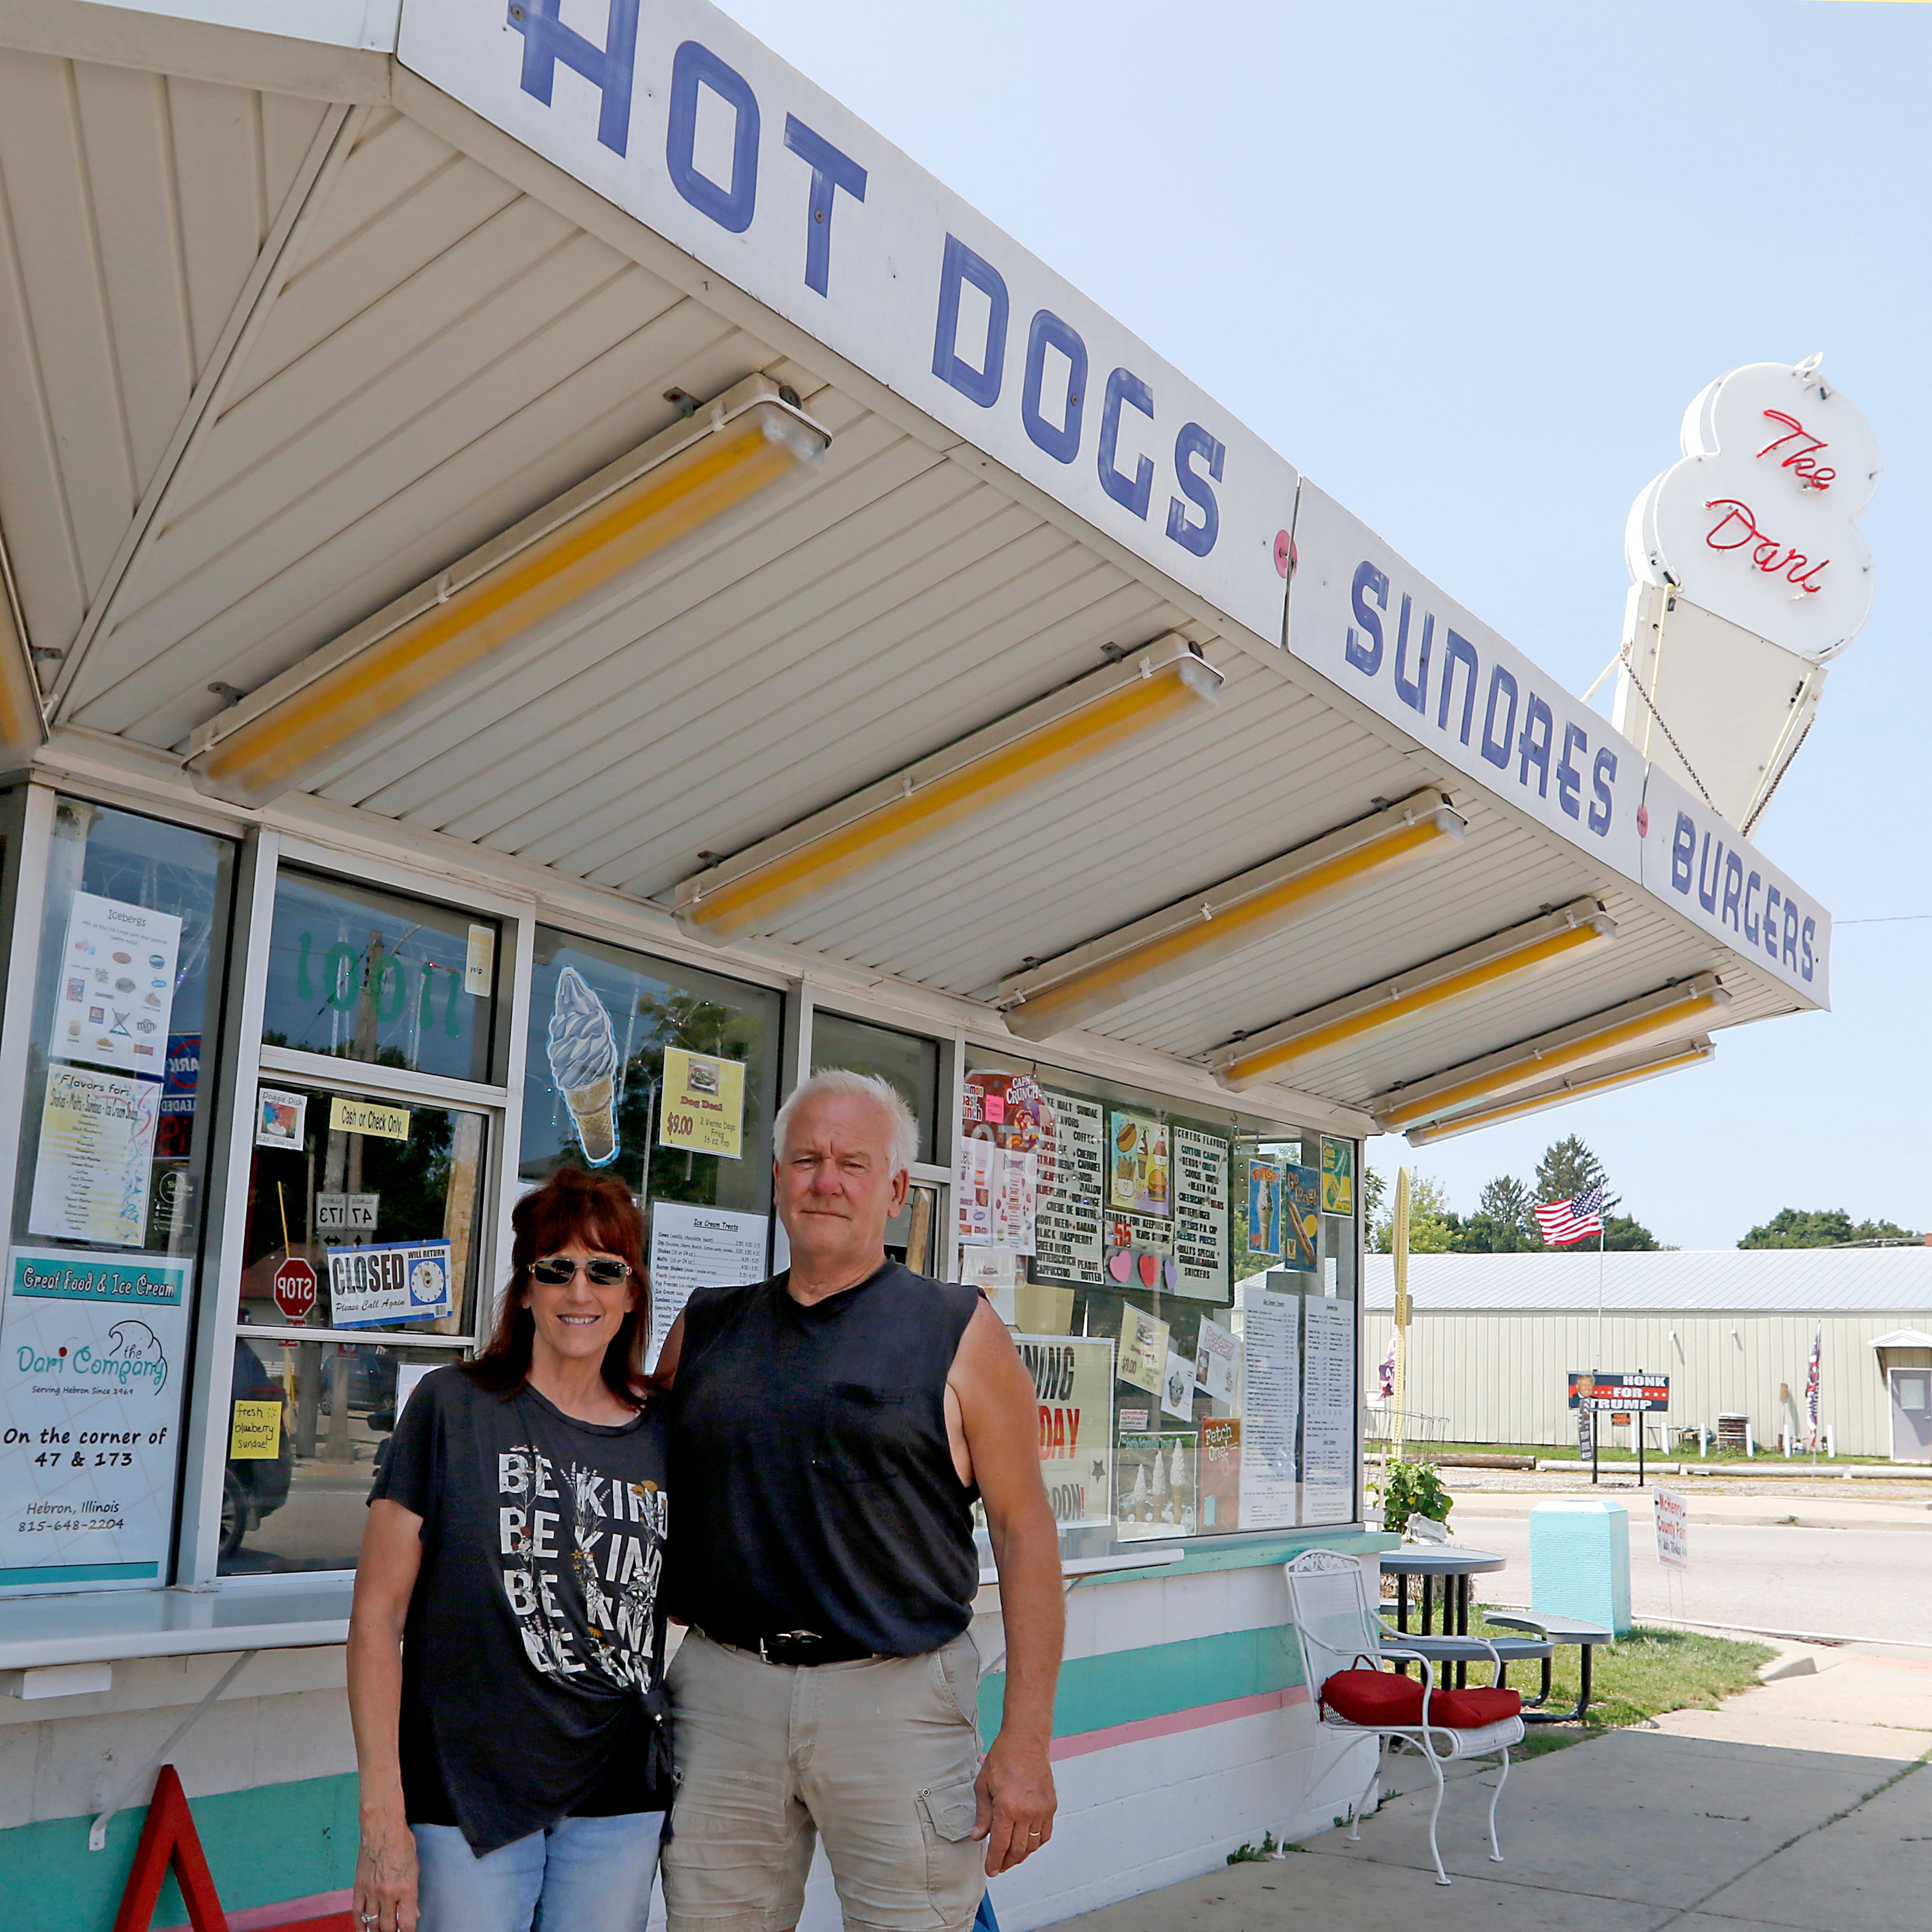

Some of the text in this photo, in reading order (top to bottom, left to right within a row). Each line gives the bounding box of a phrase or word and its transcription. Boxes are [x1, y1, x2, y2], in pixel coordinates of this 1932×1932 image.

[507, 0, 1225, 558] HOT DOGS
[1757, 409, 1836, 490] The
[1344, 560, 1618, 838] SUNDAES
[1672, 809, 1816, 983] BURGERS
[108, 910, 147, 927] Icebergs
[470, 967, 482, 975] yelp
[61, 1075, 104, 1092] Flavors
[262, 1092, 303, 1107] Doggie Dish
[1006, 1085, 1039, 1104] CRUNCH
[680, 1096, 723, 1111] Dog Deal
[1077, 1105, 1098, 1118] SUNDAE
[341, 1106, 356, 1126] Cash
[358, 1114, 366, 1126] or
[368, 1111, 386, 1131] Check
[667, 1111, 693, 1136] $9.00
[700, 1117, 736, 1133] 2 Vienna Dogs
[704, 1135, 711, 1144] 16
[721, 1138, 730, 1147] Pop
[1073, 1131, 1095, 1145] COFFEE
[1175, 1128, 1226, 1150] ICEBERG FLAVORS
[1077, 1148, 1097, 1161] CHERRY
[1181, 1145, 1220, 1162] COTTON CANDY
[1182, 1157, 1198, 1168] NERDS
[1191, 1182, 1205, 1192] HEATH
[1288, 1172, 1299, 1190] Go
[1046, 1201, 1065, 1213] CREME
[1066, 1205, 1073, 1214] DE
[694, 1219, 738, 1231] Ice Cream Treats
[1055, 1218, 1069, 1229] BEER
[1105, 1211, 1127, 1224] THANKS
[1129, 1216, 1140, 1227] FOR
[1165, 1223, 1172, 1233] US
[1060, 1231, 1093, 1246] RASPBERRY
[1114, 1221, 1132, 1247] 55
[1199, 1235, 1217, 1246] PIECES
[408, 1249, 445, 1259] WILL RETURN
[332, 1253, 405, 1296] CLOSED
[1081, 1270, 1102, 1282] BUTTER
[1184, 1267, 1210, 1279] SNICKERS
[23, 1266, 175, 1298] Great Food & Ice Cream
[335, 1299, 405, 1313] Please Call Again
[125, 1344, 142, 1359] the
[17, 1346, 164, 1385] Dari Company
[1623, 1375, 1666, 1387] HONK
[32, 1386, 60, 1396] Serving
[63, 1386, 89, 1394] Hebron
[1613, 1387, 1642, 1398] FOR
[236, 1404, 263, 1418] fresh
[1590, 1398, 1652, 1409] TRUMP
[4, 1427, 167, 1444] On the corner of
[1205, 1423, 1233, 1446] Fetch
[1209, 1439, 1228, 1461] One!
[35, 1451, 132, 1467] 47 & 173
[499, 1453, 668, 1540] BE KIND
[27, 1501, 119, 1514] Hebron, Illinois
[1659, 1493, 1682, 1520] McHenry
[18, 1519, 124, 1532] 815-648-2204
[1657, 1514, 1675, 1540] County
[500, 1506, 663, 1598] BE KIND
[503, 1570, 565, 1618] BE
